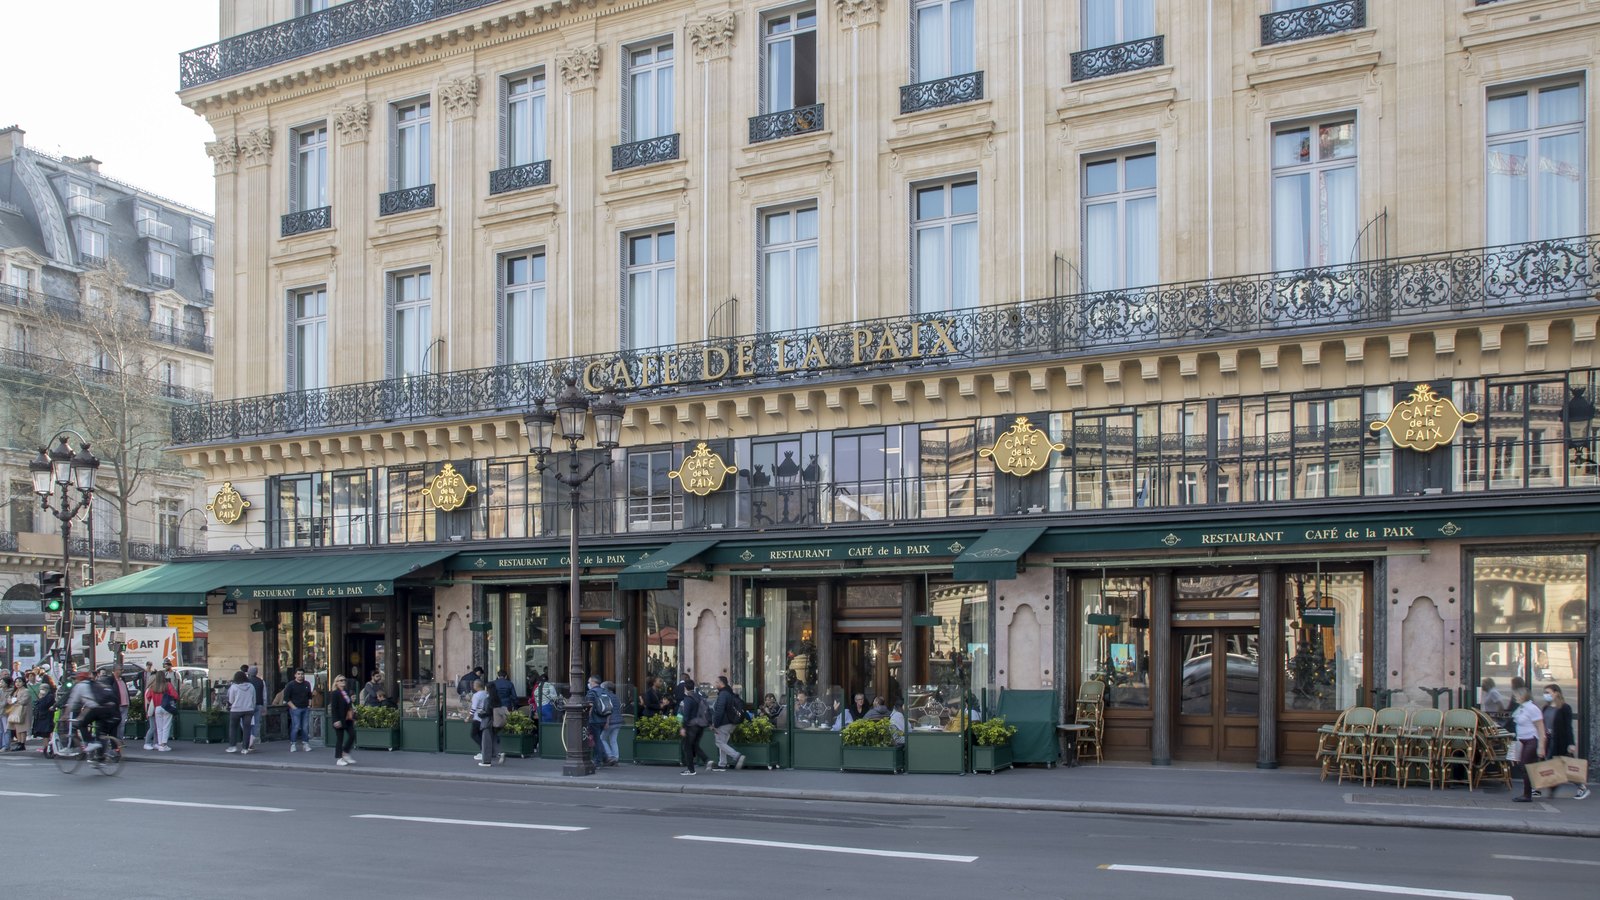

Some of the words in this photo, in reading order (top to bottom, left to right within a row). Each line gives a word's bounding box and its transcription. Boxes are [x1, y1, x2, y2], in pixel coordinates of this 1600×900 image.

[702, 341, 754, 380] DE
[776, 335, 830, 373] LA
[851, 317, 958, 364] PAIX
[1410, 419, 1422, 427] de
[1425, 418, 1435, 426] la
[1406, 427, 1442, 440] PAIX
[1012, 448, 1022, 456] de
[1008, 456, 1037, 468] PAIX
[690, 476, 714, 487] PAIX
[438, 494, 458, 504] PAIX
[219, 510, 236, 519] PAIX
[1202, 532, 1284, 544] RESTAURANT
[1305, 527, 1338, 540] CAFÉ
[1345, 529, 1359, 538] de
[1366, 528, 1376, 538] la
[1383, 527, 1414, 537] PAIX
[770, 549, 832, 559] RESTAURANT
[848, 545, 873, 556] CAFÉ
[878, 546, 889, 555] de
[894, 546, 902, 555] la
[907, 545, 930, 554] PAIX
[499, 558, 548, 567] RESTAURANT
[560, 556, 581, 565] CA
[584, 556, 593, 564] de
[596, 556, 602, 564] la
[607, 555, 625, 563] PAIX
[253, 589, 296, 597] RESTAURANT
[307, 586, 324, 596] CAFÉ
[338, 587, 344, 595] la
[347, 586, 363, 594] PAIX
[140, 640, 160, 648] ART
